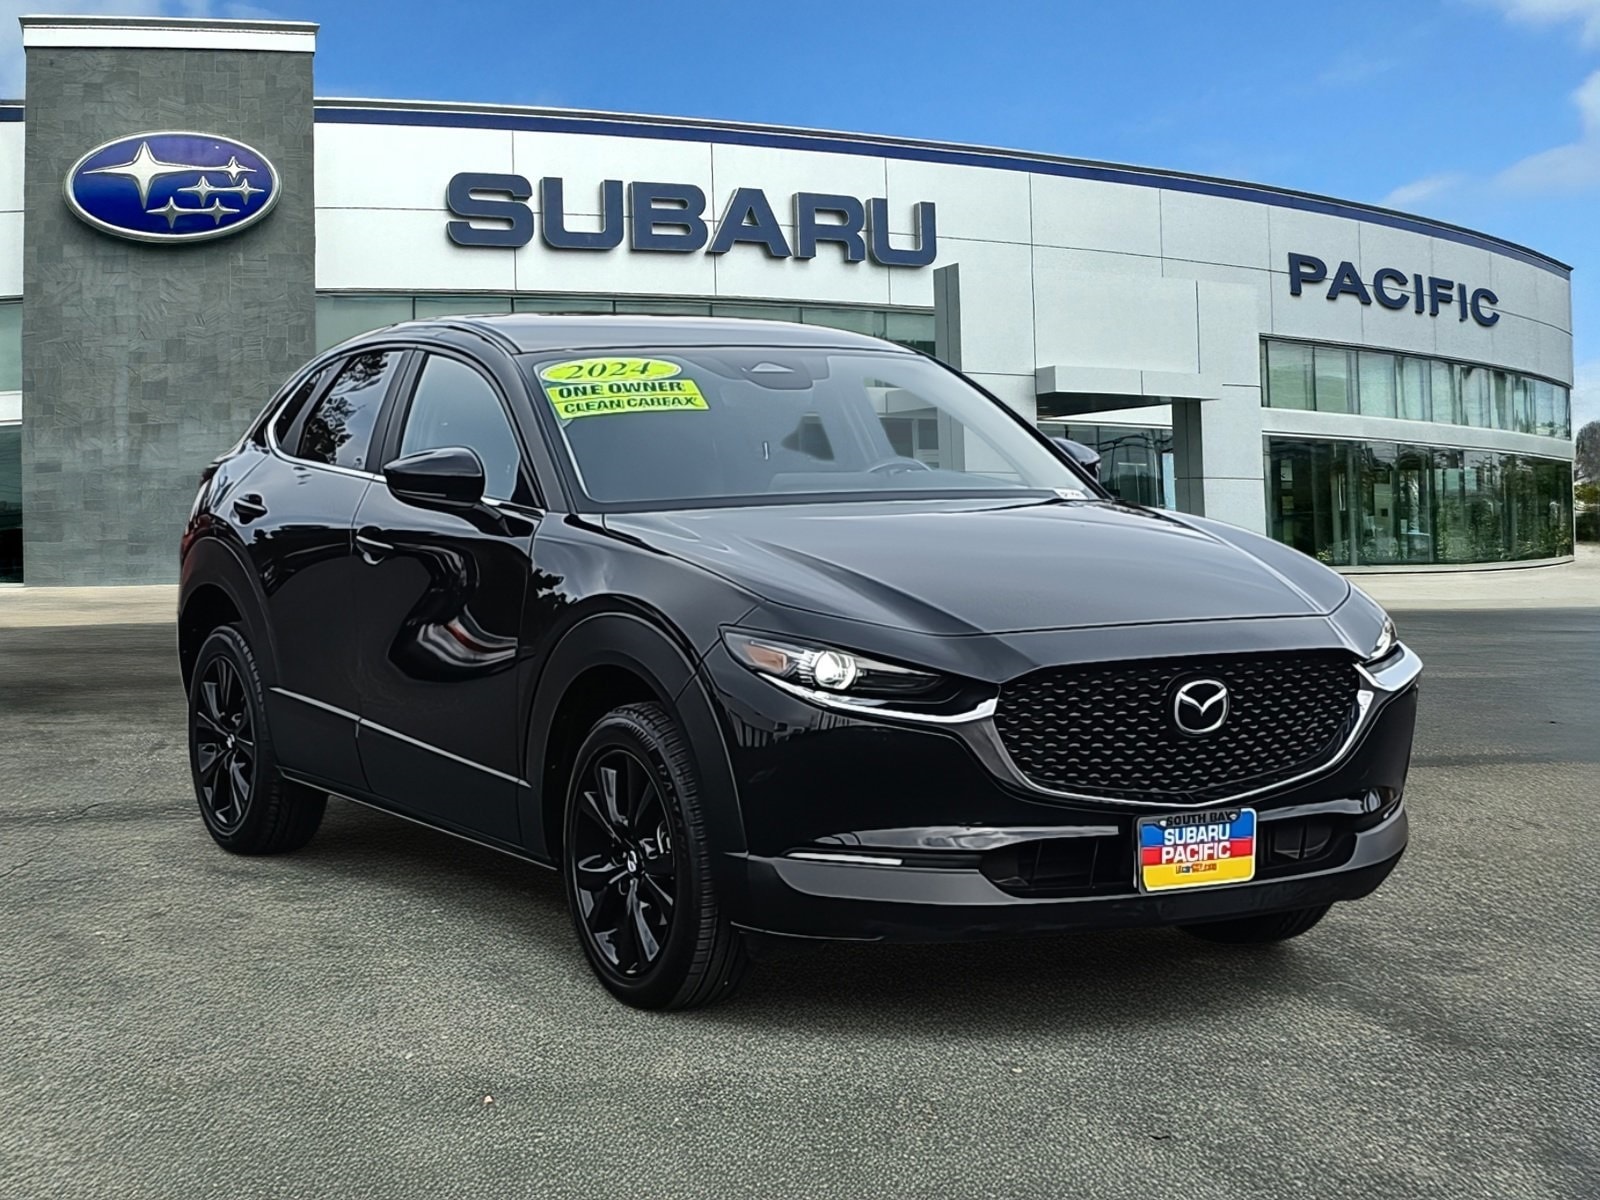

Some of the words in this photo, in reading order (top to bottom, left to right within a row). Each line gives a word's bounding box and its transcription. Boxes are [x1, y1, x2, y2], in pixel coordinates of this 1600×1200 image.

[447, 171, 937, 268] SUBARU
[1287, 252, 1501, 328] PACIFIC
[564, 361, 651, 380] 2024
[558, 384, 604, 399] ONE
[608, 381, 683, 395] OWNER
[564, 400, 624, 414] CLEAN
[1166, 814, 1207, 826] SOUTH
[1209, 811, 1232, 822] BAY
[1164, 824, 1231, 846] SUBARU
[1161, 841, 1231, 864] PACIFIC
